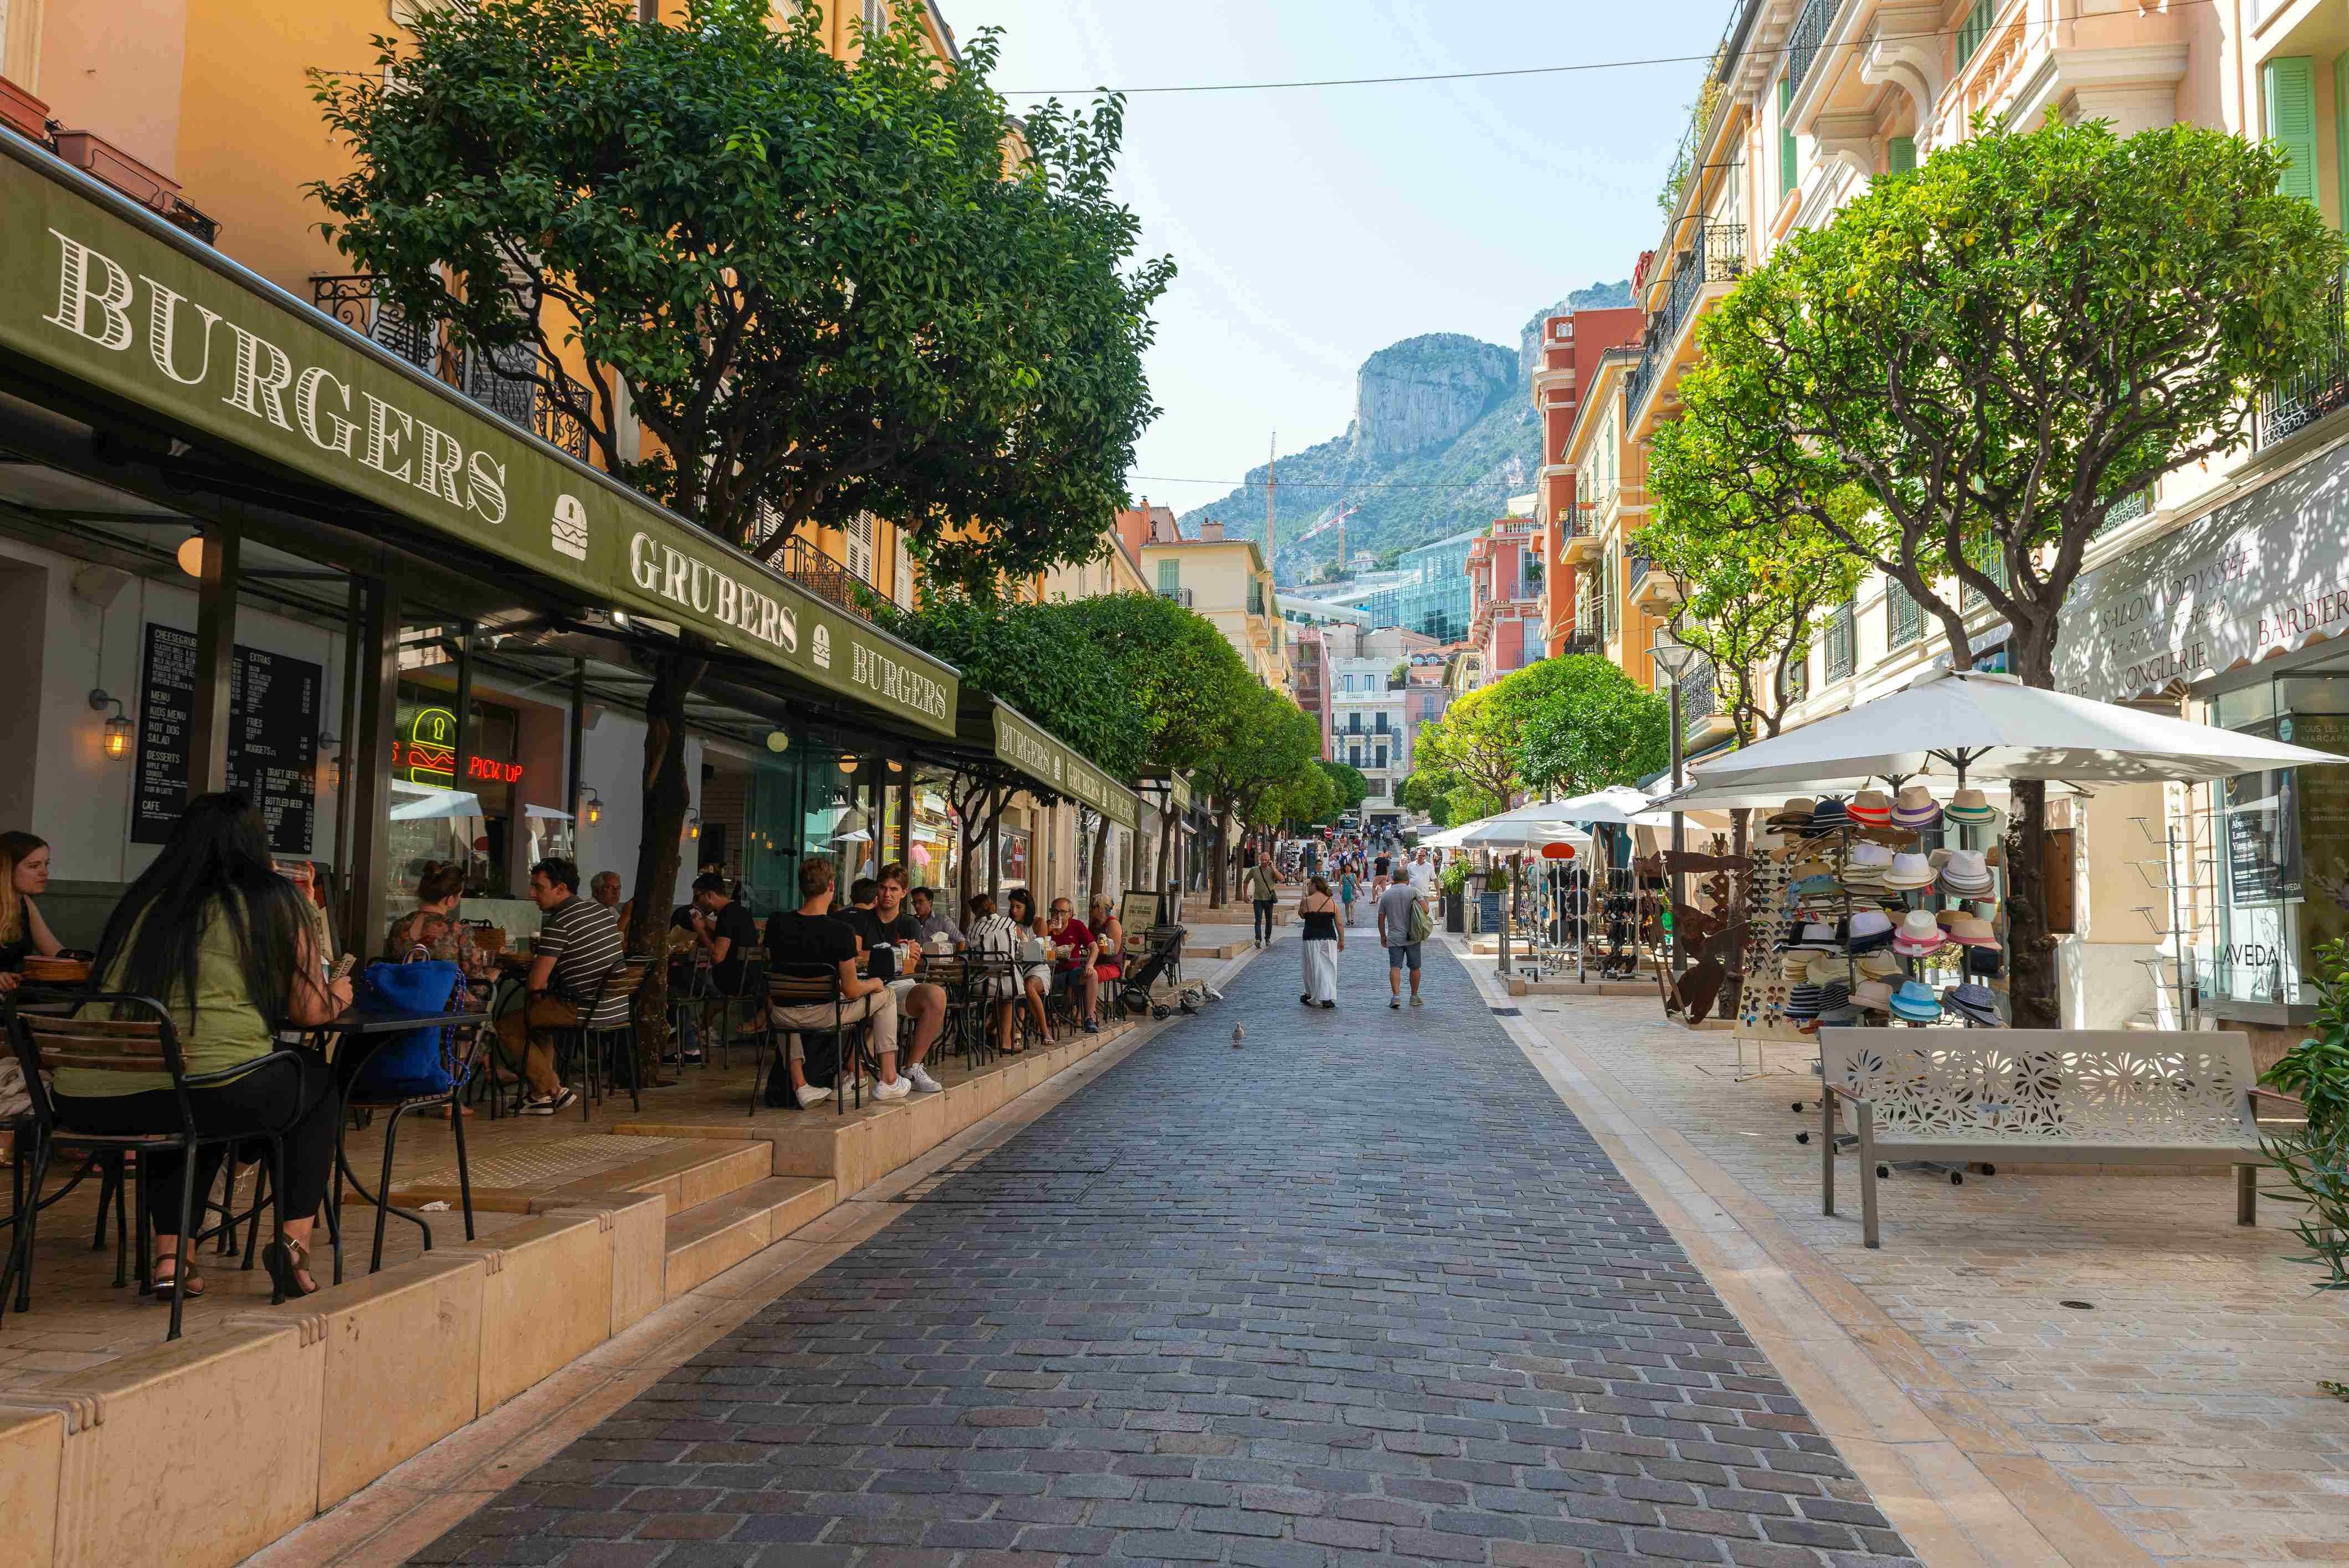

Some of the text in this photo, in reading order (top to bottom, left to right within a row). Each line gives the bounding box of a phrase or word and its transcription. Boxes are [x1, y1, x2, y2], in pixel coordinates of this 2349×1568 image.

[43, 228, 507, 524] BURGERS
[630, 532, 798, 654] GRUBERS
[2101, 587, 2157, 634] SALON
[249, 652, 271, 665] EXTRAS
[2126, 642, 2206, 689] ONGLERIE
[851, 641, 947, 720] BURGERS
[151, 690, 171, 702] MENU
[167, 709, 187, 721] MENU
[148, 721, 181, 736] HOT DOG
[247, 717, 263, 728] FRIES
[147, 733, 171, 745] SALAD
[244, 744, 271, 756] NUGGETS
[1001, 721, 1050, 776] BURGERS
[146, 750, 181, 764] DESSERTS
[285, 770, 300, 780] BEER
[469, 754, 523, 783] PICK UP
[1067, 762, 1100, 803] GRUBERS
[142, 800, 160, 811] CAFE
[265, 796, 304, 809] BOTTLED BEER
[1110, 790, 1135, 823] BURGERS
[2284, 883, 2302, 891] AVEDA
[2223, 944, 2279, 967] AVEDA
